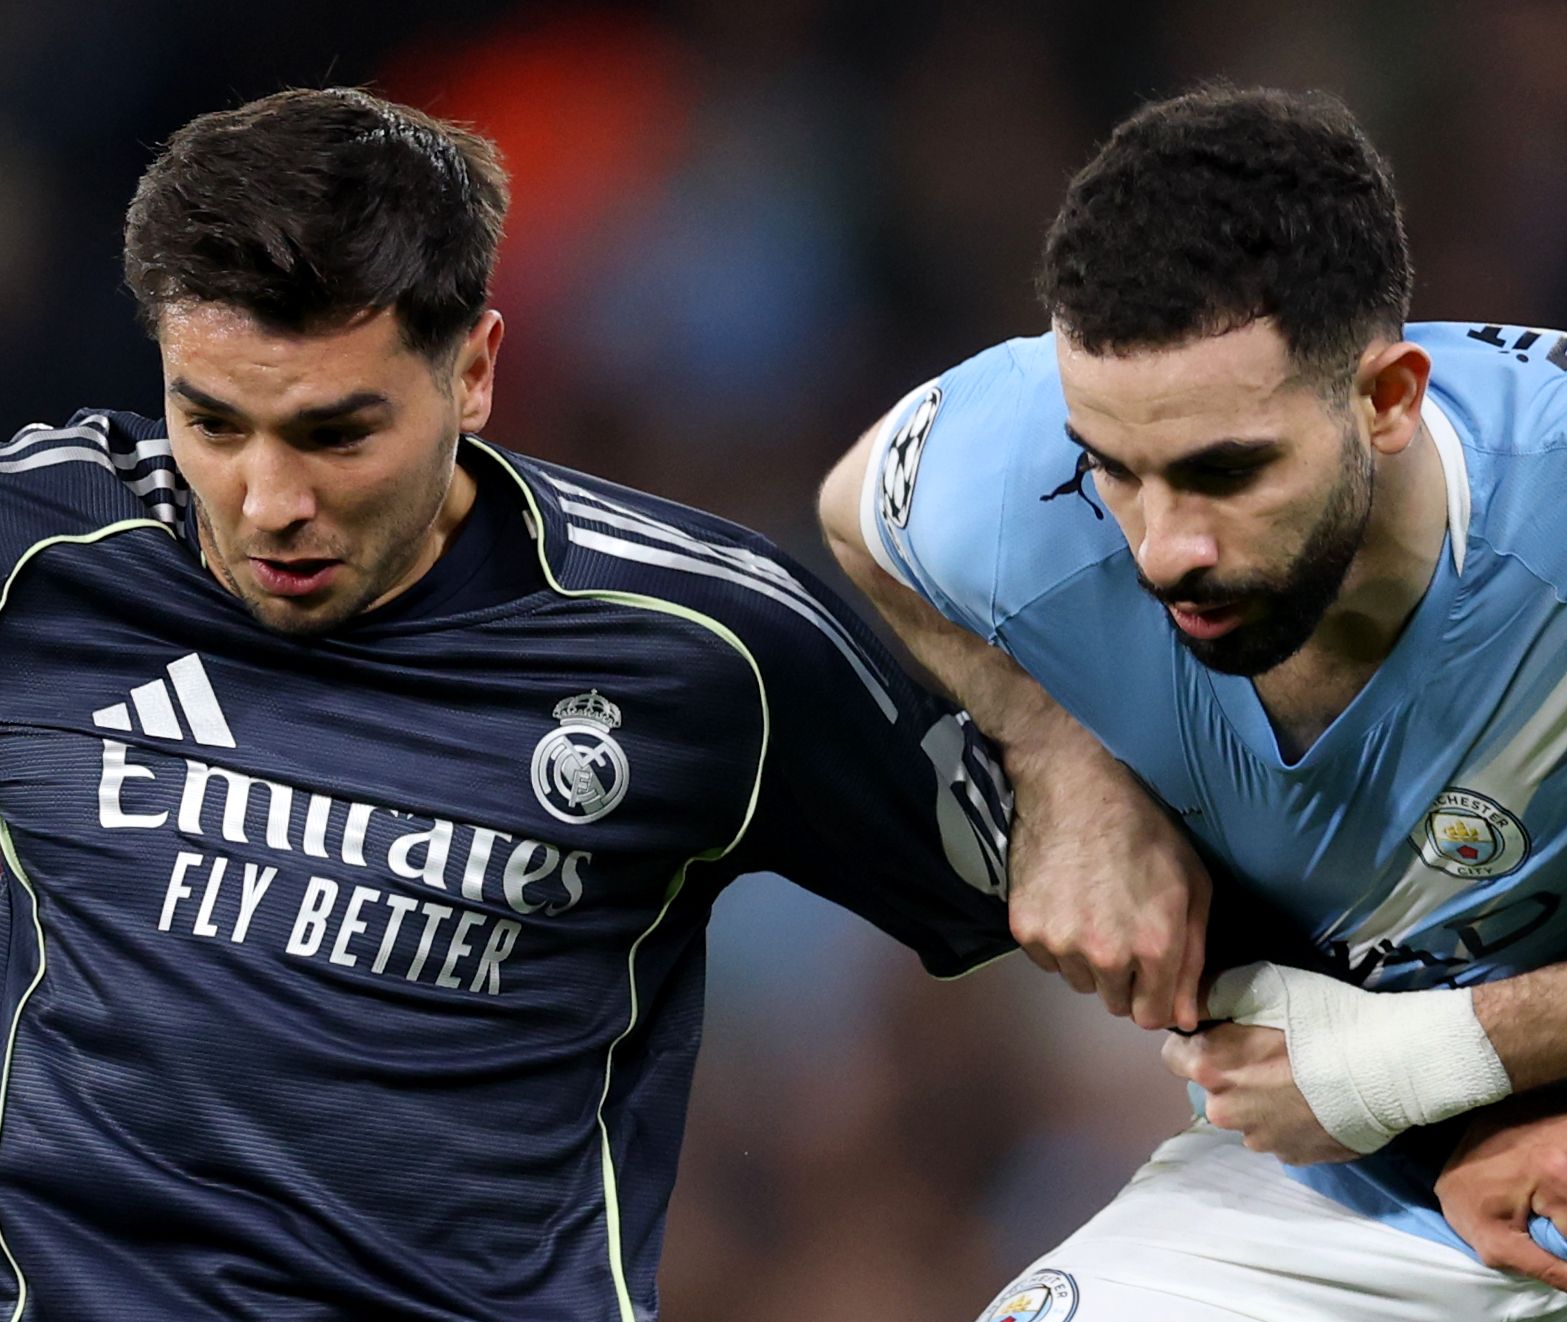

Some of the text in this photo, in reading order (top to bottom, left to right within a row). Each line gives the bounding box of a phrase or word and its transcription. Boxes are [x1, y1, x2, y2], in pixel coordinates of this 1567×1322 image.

[98, 737, 593, 918] Emirates
[1432, 793, 1510, 830] CHESTER
[1457, 866, 1492, 876] CITY
[157, 851, 523, 996] FLY BETTER
